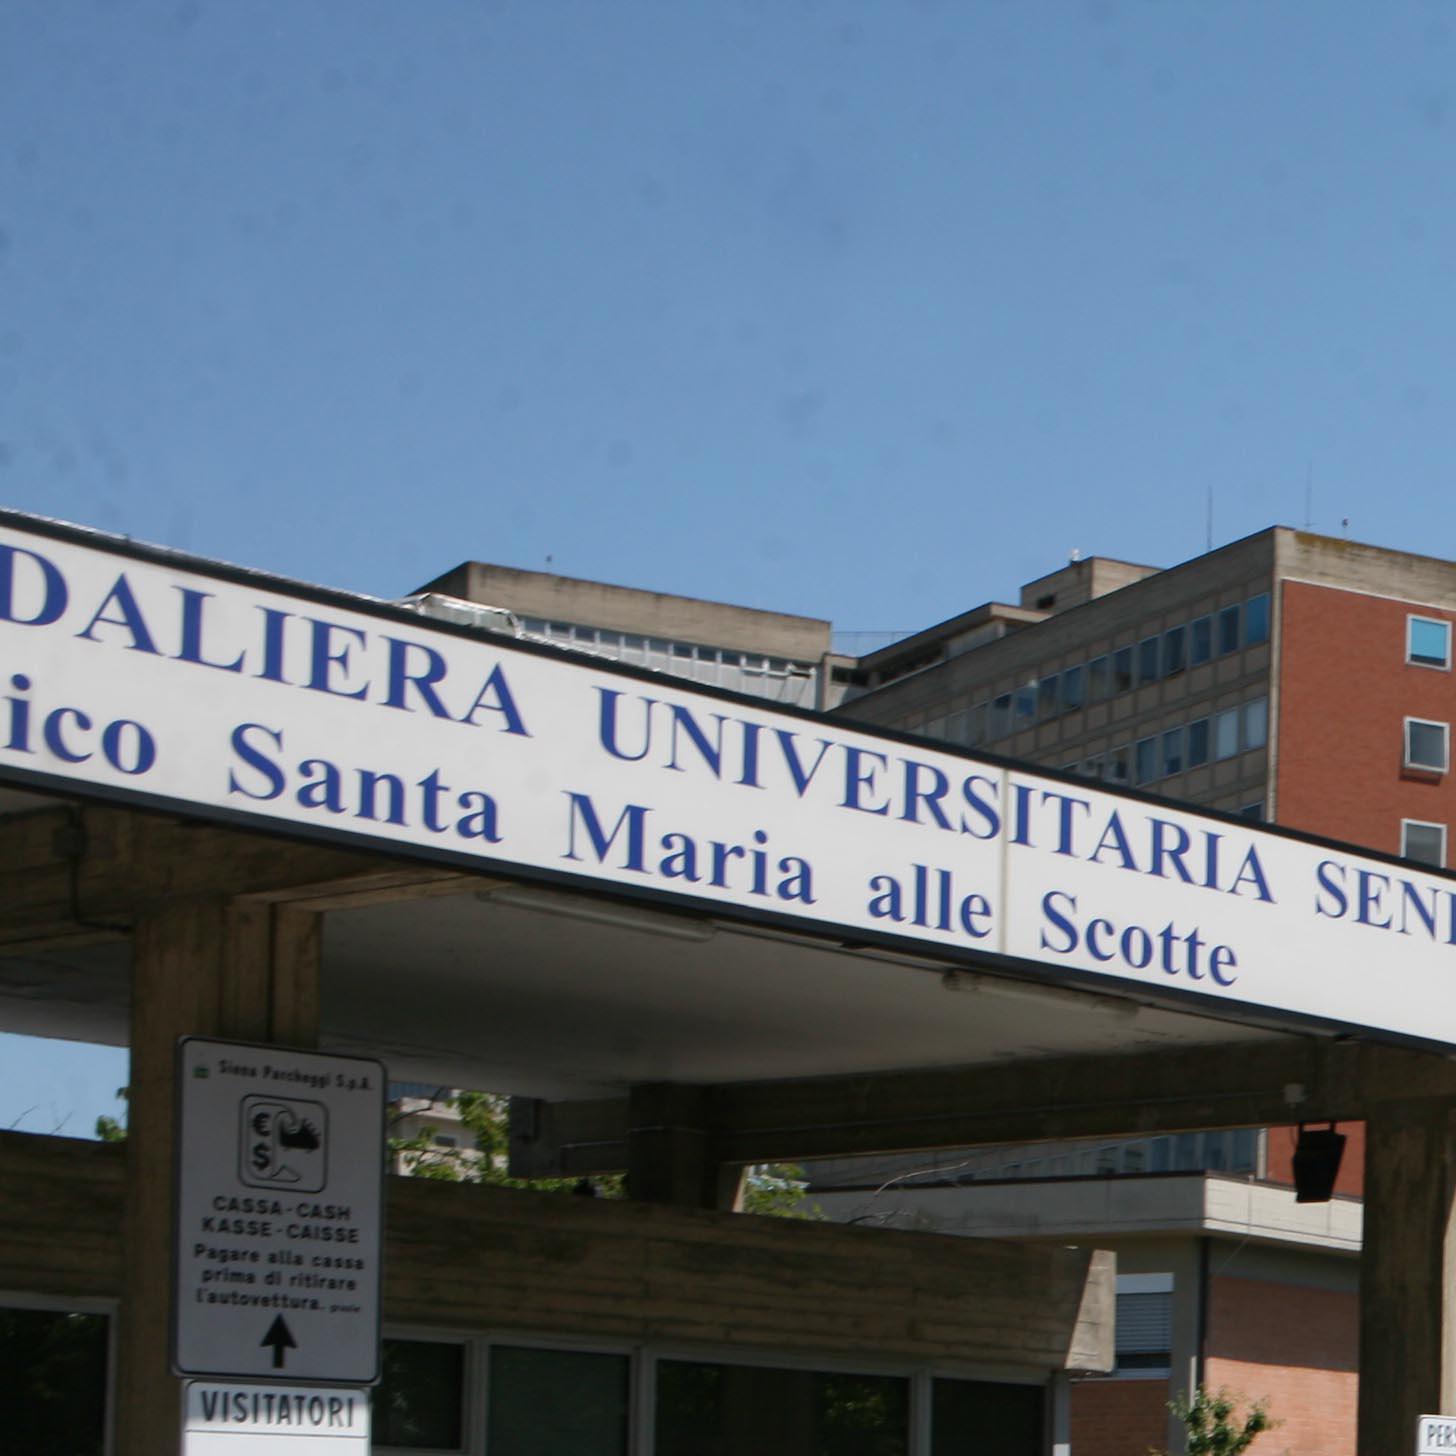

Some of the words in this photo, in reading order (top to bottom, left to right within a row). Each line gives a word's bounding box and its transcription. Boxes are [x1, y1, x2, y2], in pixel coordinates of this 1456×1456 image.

[0, 545, 533, 738] DALIERA
[592, 686, 1278, 904] UNIVERSITARIA
[3, 673, 158, 776] ico
[227, 722, 504, 843] Santa
[560, 790, 818, 905] Maria
[867, 863, 993, 939] alle
[1040, 889, 1239, 987] Scotte
[218, 1059, 258, 1078] Siena
[262, 1065, 330, 1089] Parcheggi
[193, 1242, 259, 1264] Pagare
[266, 1249, 304, 1266] alla
[310, 1254, 365, 1271] cassa
[201, 1268, 256, 1285] prima
[264, 1270, 283, 1286] di
[289, 1273, 356, 1292] ritirare
[201, 1389, 355, 1428] VISITATORI
